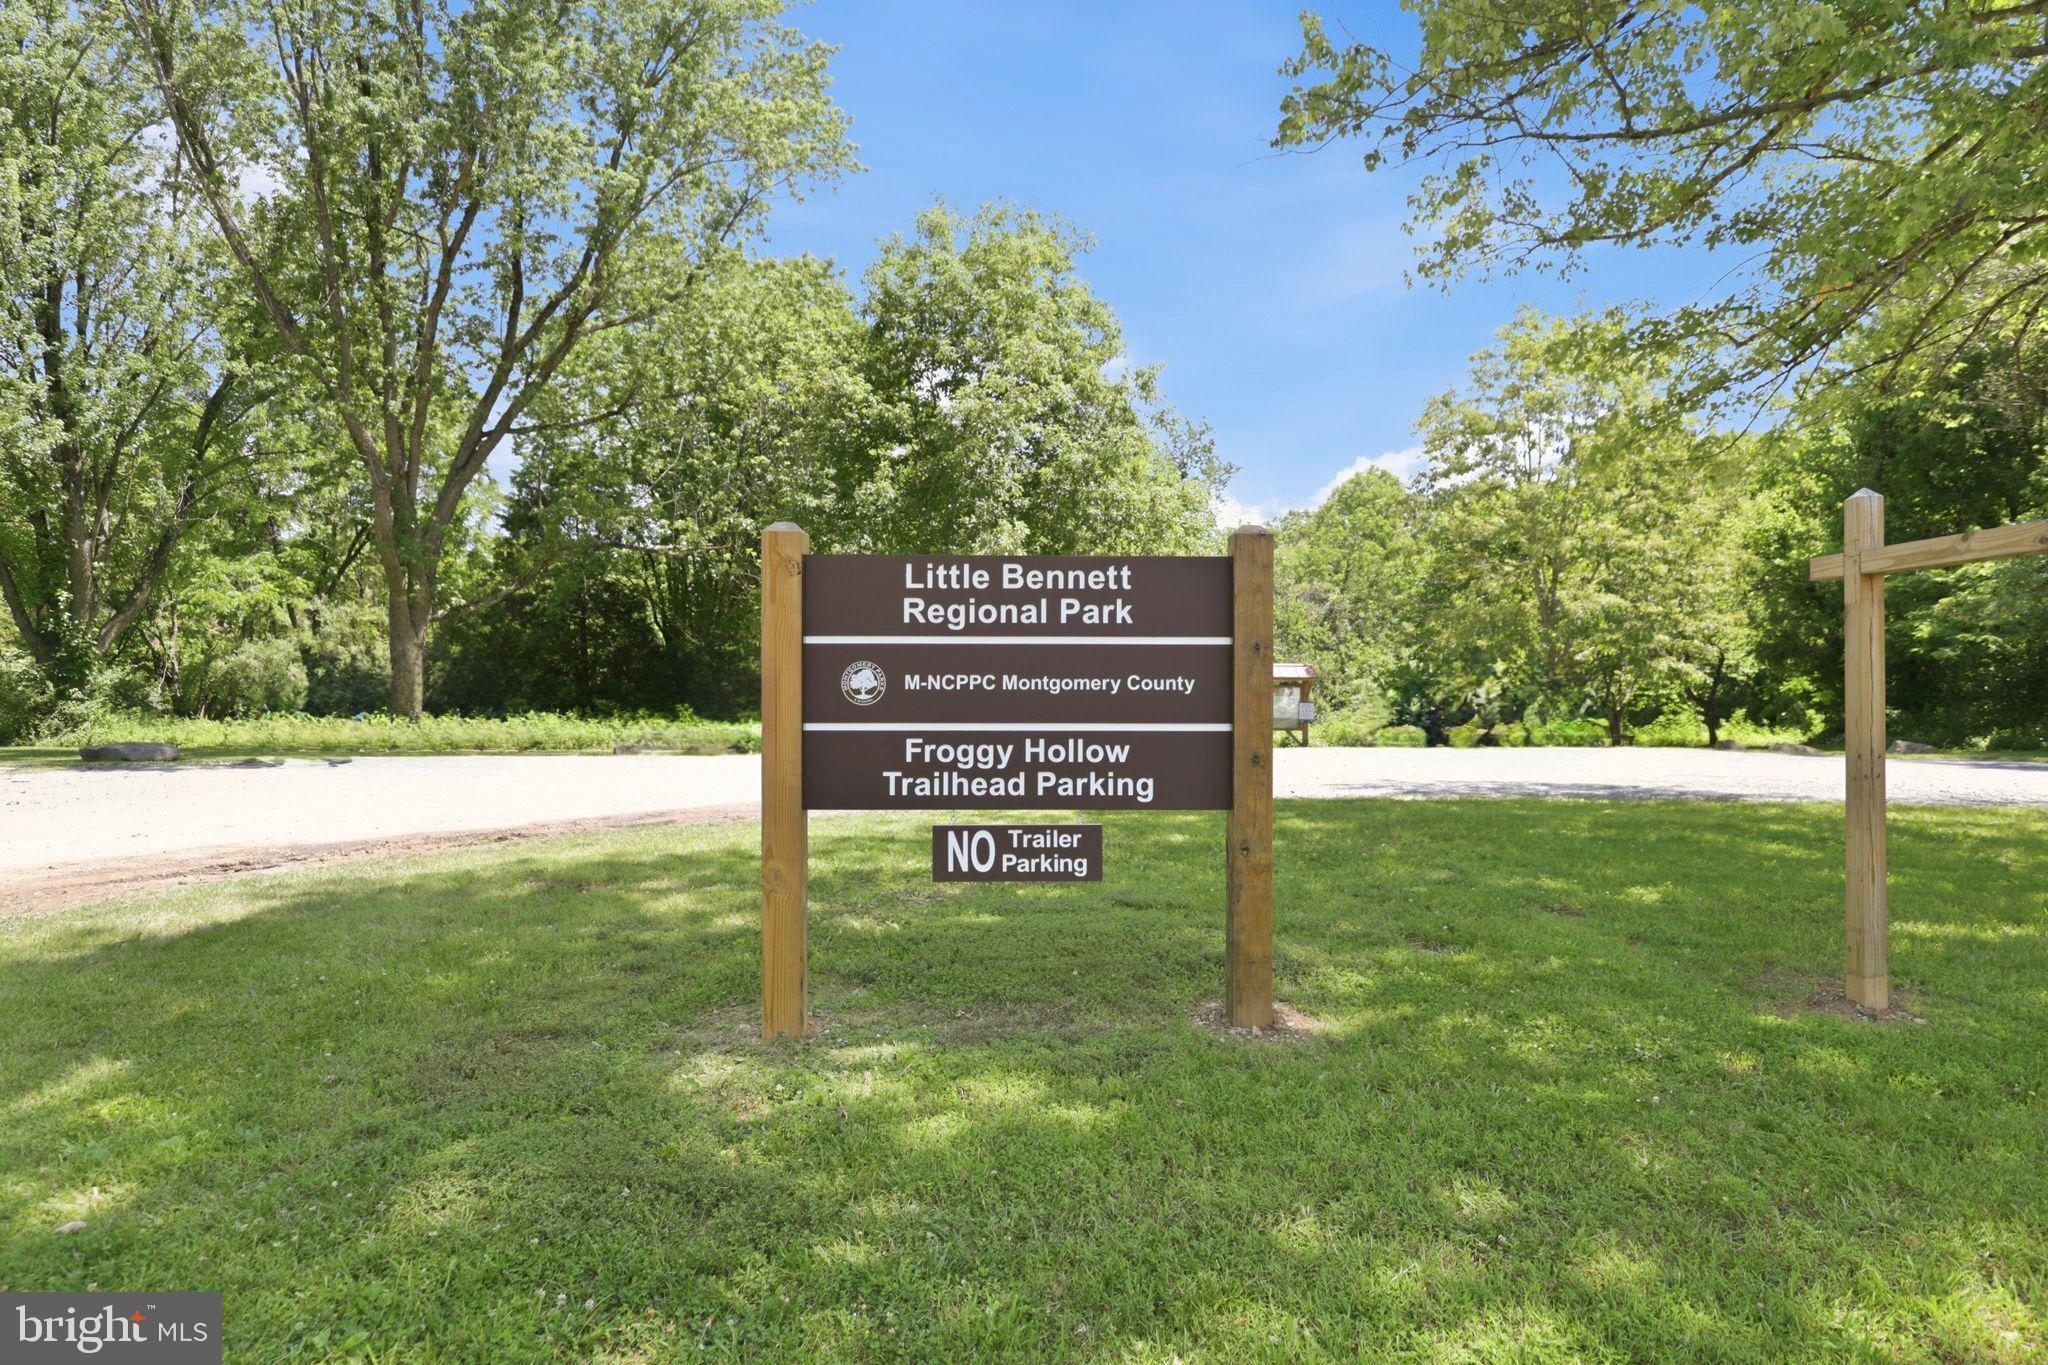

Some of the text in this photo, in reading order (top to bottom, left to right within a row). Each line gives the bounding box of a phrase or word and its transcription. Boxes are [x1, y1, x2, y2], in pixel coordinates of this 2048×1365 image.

[906, 563, 1131, 589] Little Bennett
[904, 598, 1133, 630] Regional Park
[905, 675, 1194, 694] M-NCPPC Montgomery County
[906, 739, 1130, 769] Froggy Hollow
[883, 772, 1153, 802] Trailhead Parking
[948, 830, 995, 872] NO
[1008, 830, 1081, 848] Trailer
[1003, 854, 1087, 876] Parking
